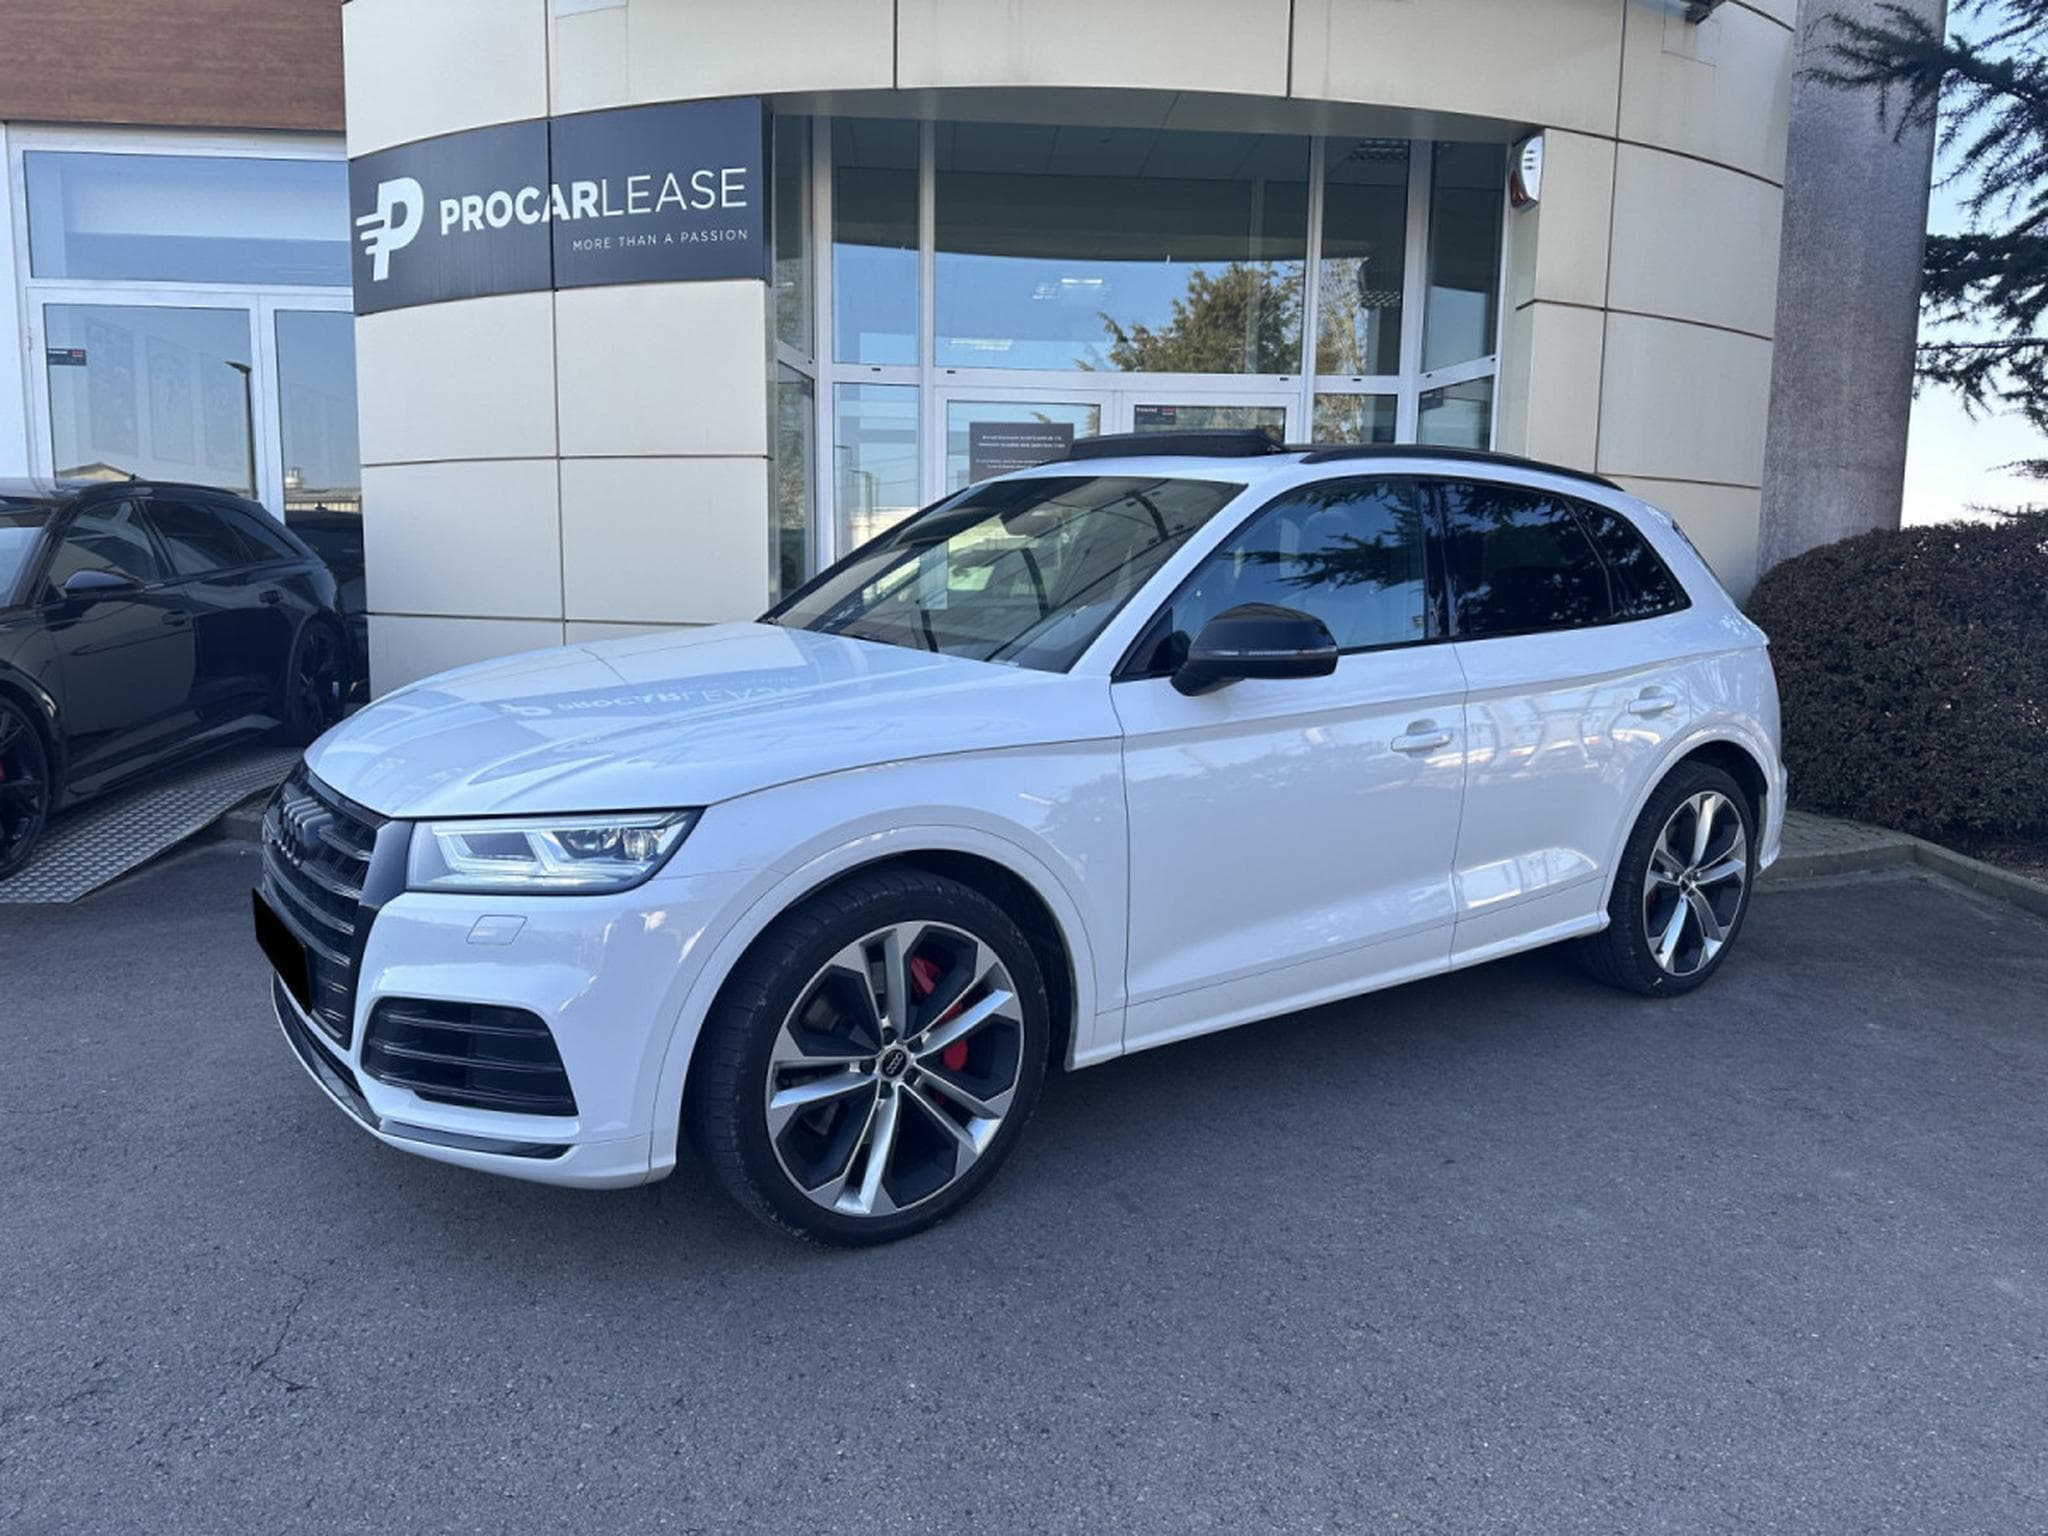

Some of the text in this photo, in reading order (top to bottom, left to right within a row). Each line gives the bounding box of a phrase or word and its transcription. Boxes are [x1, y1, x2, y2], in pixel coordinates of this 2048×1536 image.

[440, 167, 748, 236] PROCARLEASE
[572, 229, 749, 251] MORE THAN A PASSION
